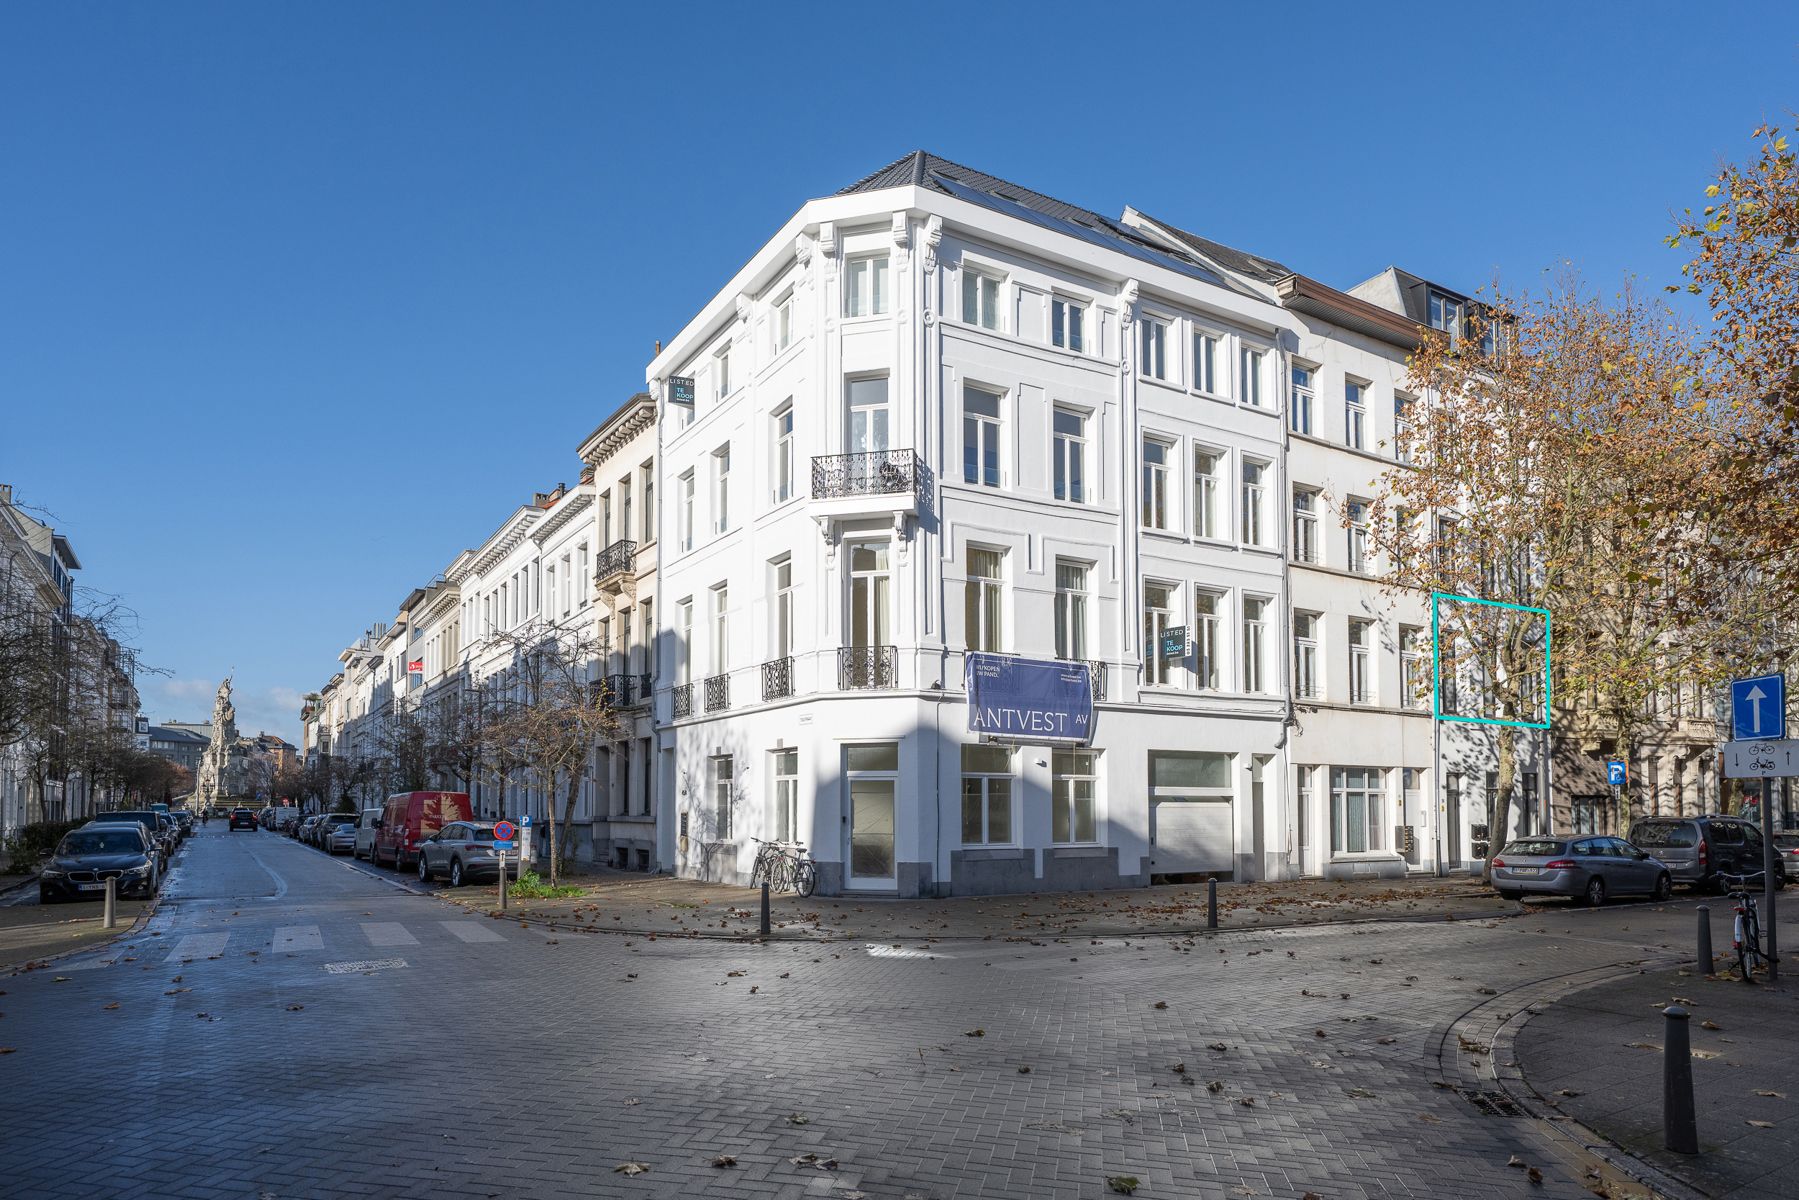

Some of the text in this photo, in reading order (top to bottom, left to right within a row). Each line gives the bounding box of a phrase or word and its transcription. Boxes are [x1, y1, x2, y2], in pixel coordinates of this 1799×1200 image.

[1160, 629, 1184, 638] LISTED
[973, 707, 1088, 732] ANTVEST AV
[522, 816, 529, 826] P
